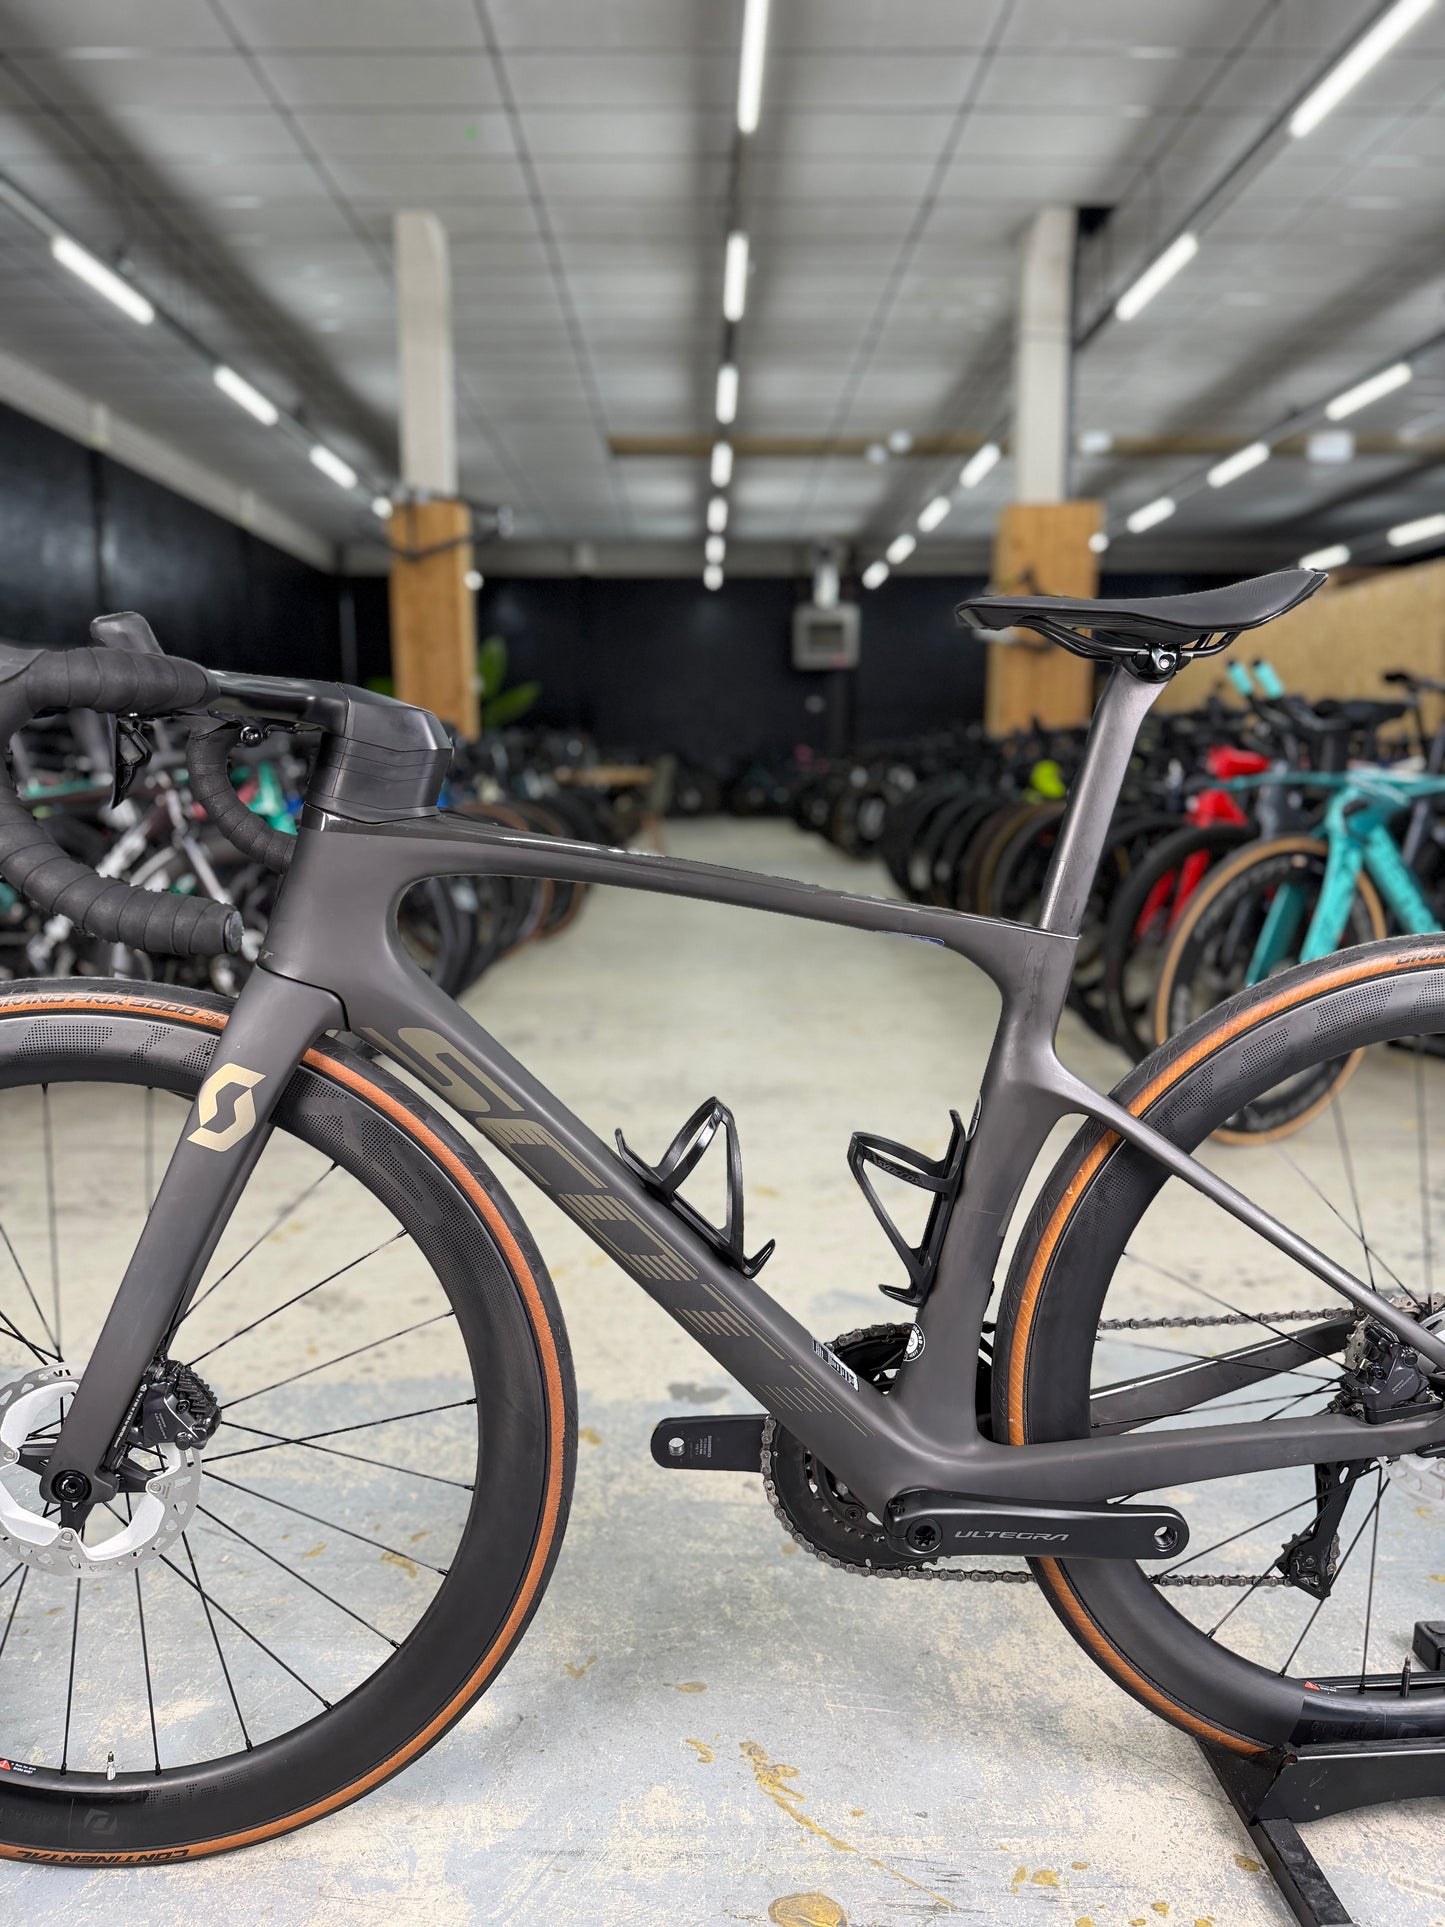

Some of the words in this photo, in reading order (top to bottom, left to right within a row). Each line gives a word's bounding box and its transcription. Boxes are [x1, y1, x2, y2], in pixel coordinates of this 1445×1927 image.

[0, 993, 67, 1007] RAND
[129, 999, 199, 1016] 5000
[360, 1027, 876, 1437] SCOTT
[954, 1530, 1069, 1541] ULTEGRA
[17, 1849, 190, 1865] CONTINENTAL
